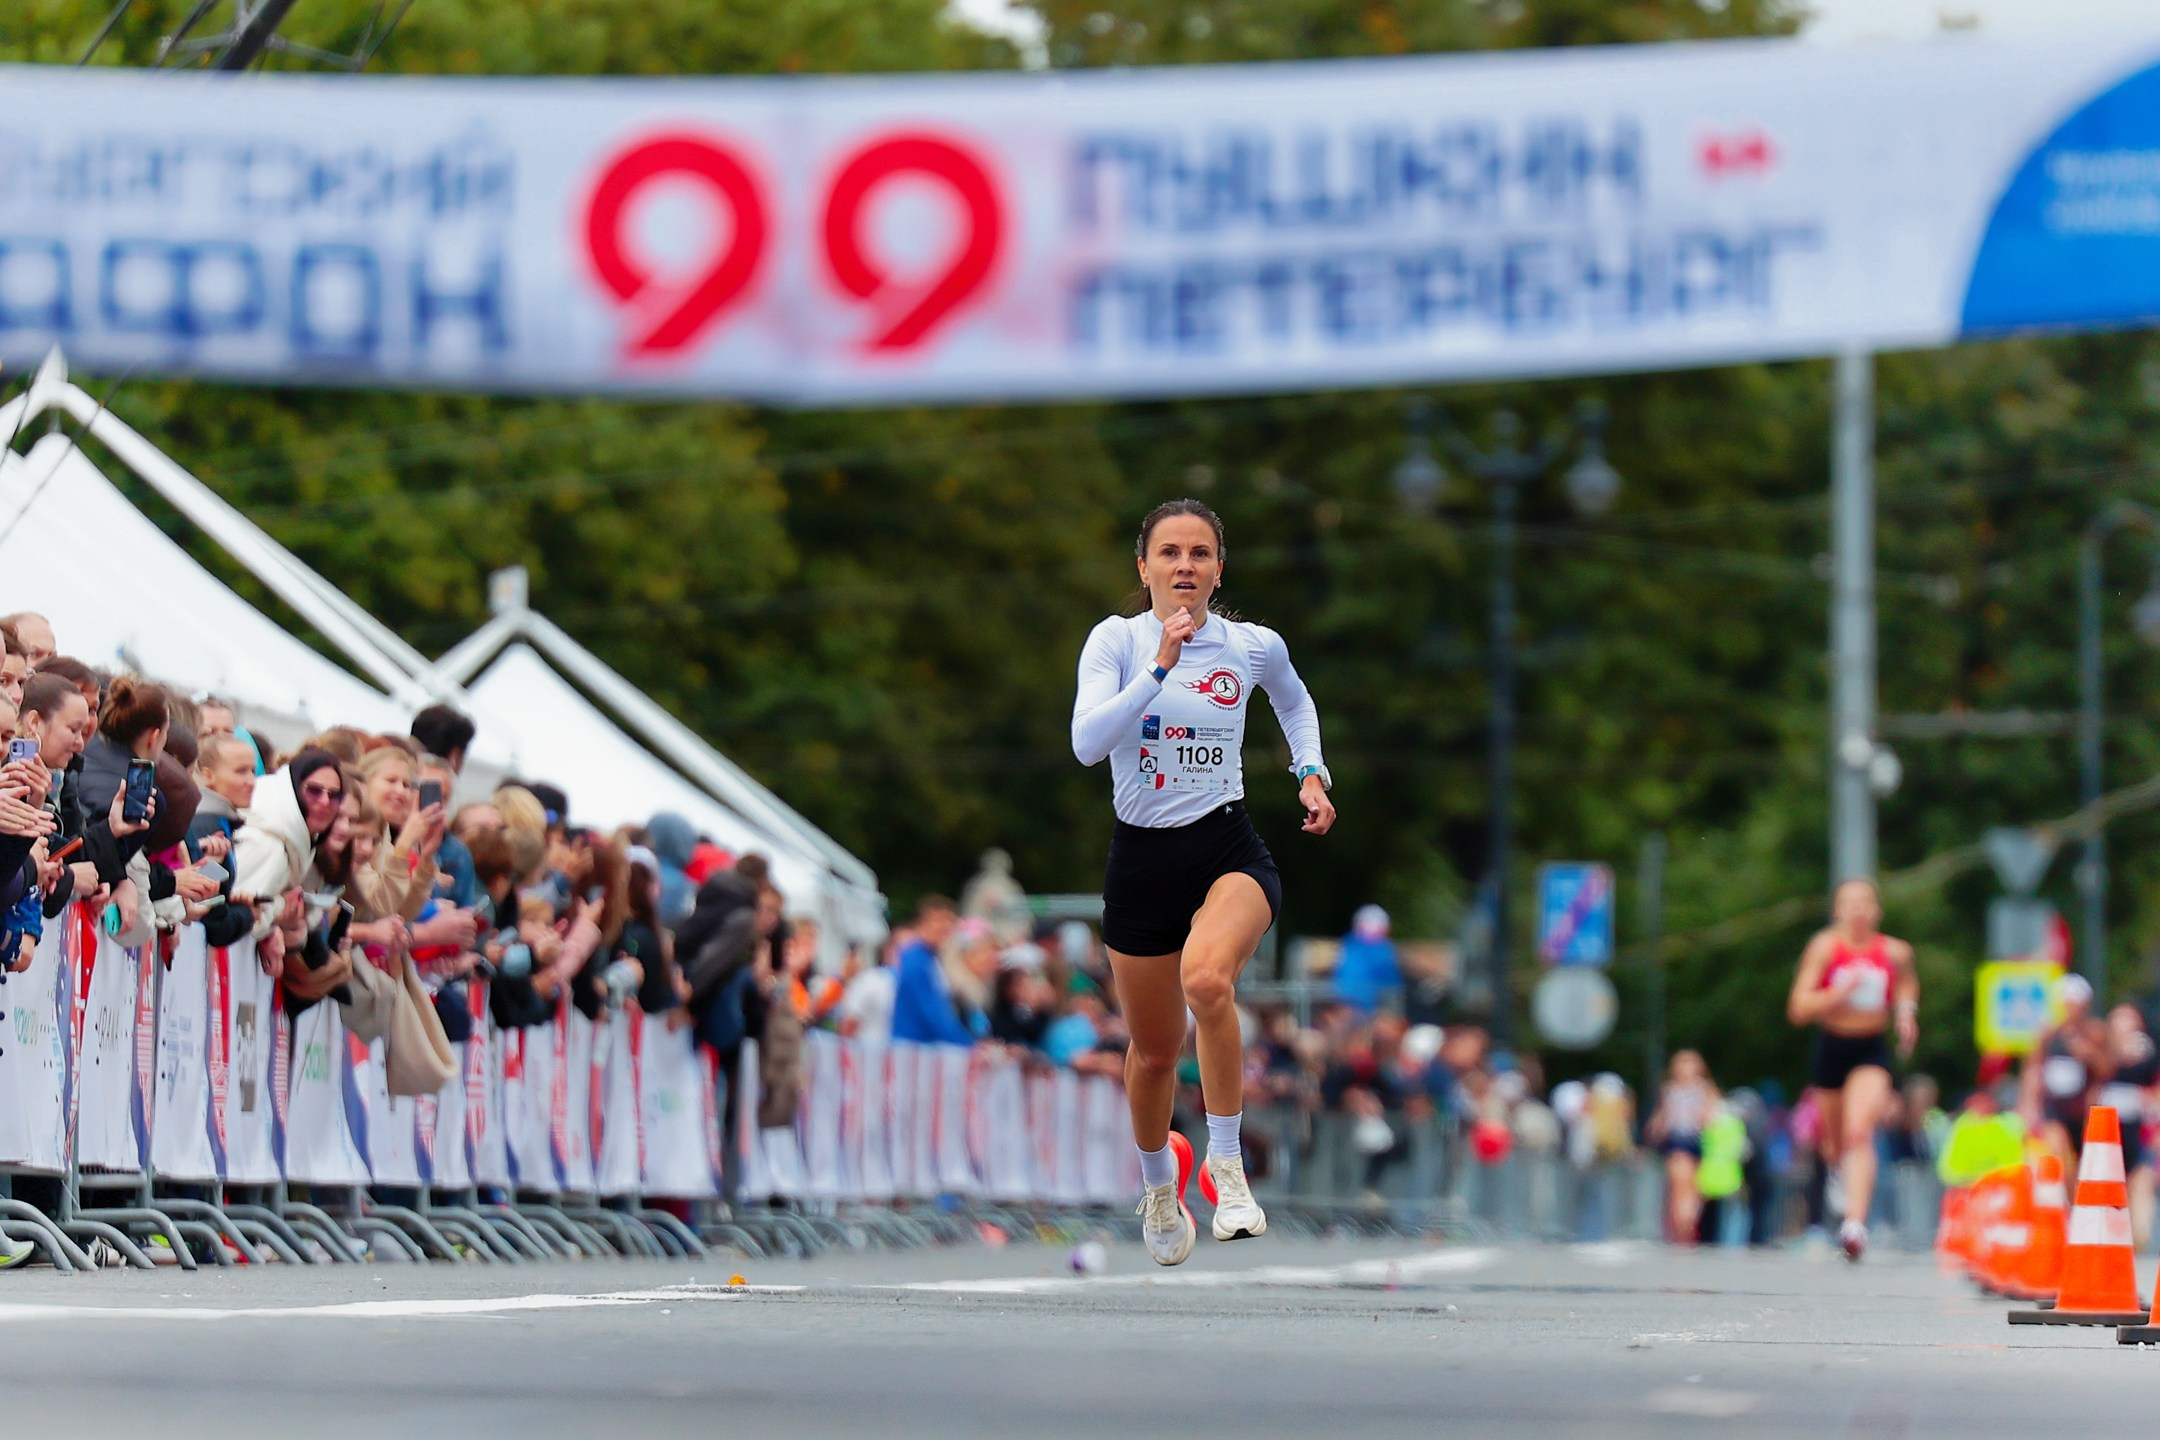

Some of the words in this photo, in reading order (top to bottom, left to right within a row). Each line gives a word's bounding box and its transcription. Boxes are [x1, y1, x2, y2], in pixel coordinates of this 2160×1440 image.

[1070, 116, 1642, 224] ПУШКИН
[581, 131, 1009, 357] 99
[1072, 220, 1822, 345] ПЕТЕРБУРГ
[1165, 727, 1186, 740] 99
[1176, 745, 1223, 766] 1108
[1182, 766, 1214, 774] ГАЛИНА
